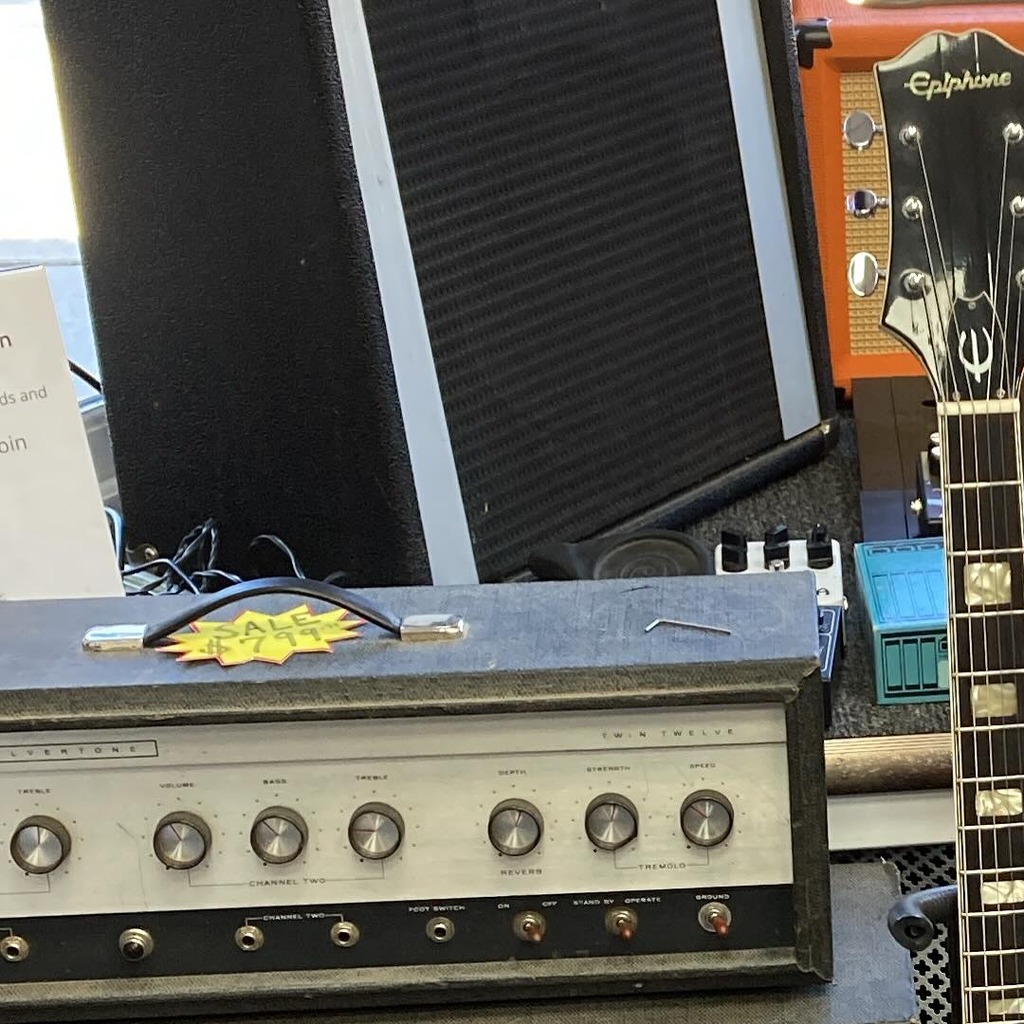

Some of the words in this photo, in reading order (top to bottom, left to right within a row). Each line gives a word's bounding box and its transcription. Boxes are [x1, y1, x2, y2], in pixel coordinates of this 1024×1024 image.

[904, 70, 1012, 101] Epiphone
[20, 384, 48, 403] and
[213, 613, 321, 640] SALE
[602, 731, 647, 739] TWIN
[661, 728, 734, 737] TWELVE
[586, 765, 631, 773] STRENGTH
[638, 862, 687, 870] TREMOLO
[500, 868, 543, 876] REVERB
[249, 879, 299, 887] CHANNEL
[303, 877, 326, 885] TWO
[541, 900, 558, 908] OFF
[572, 899, 601, 907] STAND
[624, 897, 661, 905] OPERATE
[433, 904, 466, 912] SWITCH
[262, 914, 303, 922] CHANNEL
[305, 911, 325, 919] TWO
